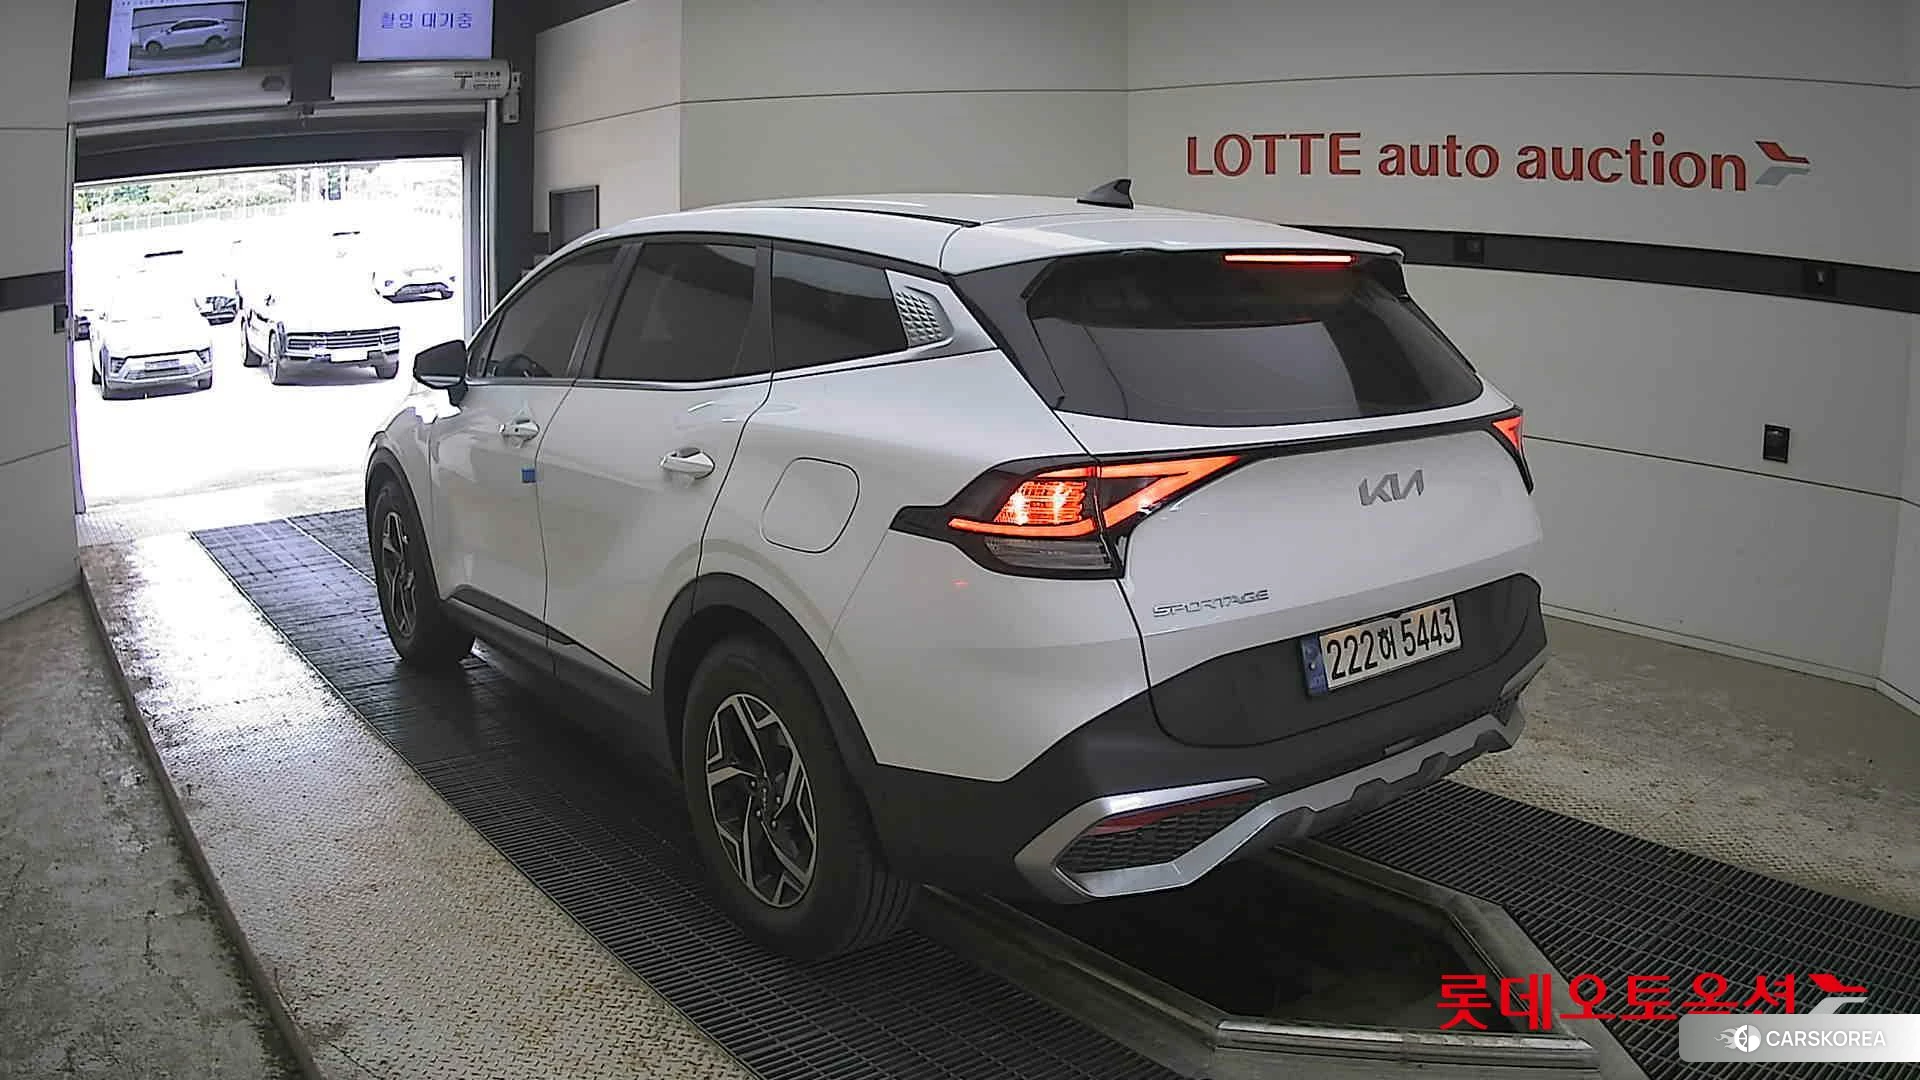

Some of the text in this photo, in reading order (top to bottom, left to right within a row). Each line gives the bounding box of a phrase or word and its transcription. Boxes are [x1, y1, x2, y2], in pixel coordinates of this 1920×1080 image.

[1187, 131, 1746, 191] LOTTE auto auction
[1359, 469, 1424, 505] KIA
[1152, 589, 1270, 617] SPORTAGE
[1401, 606, 1455, 657] 5443
